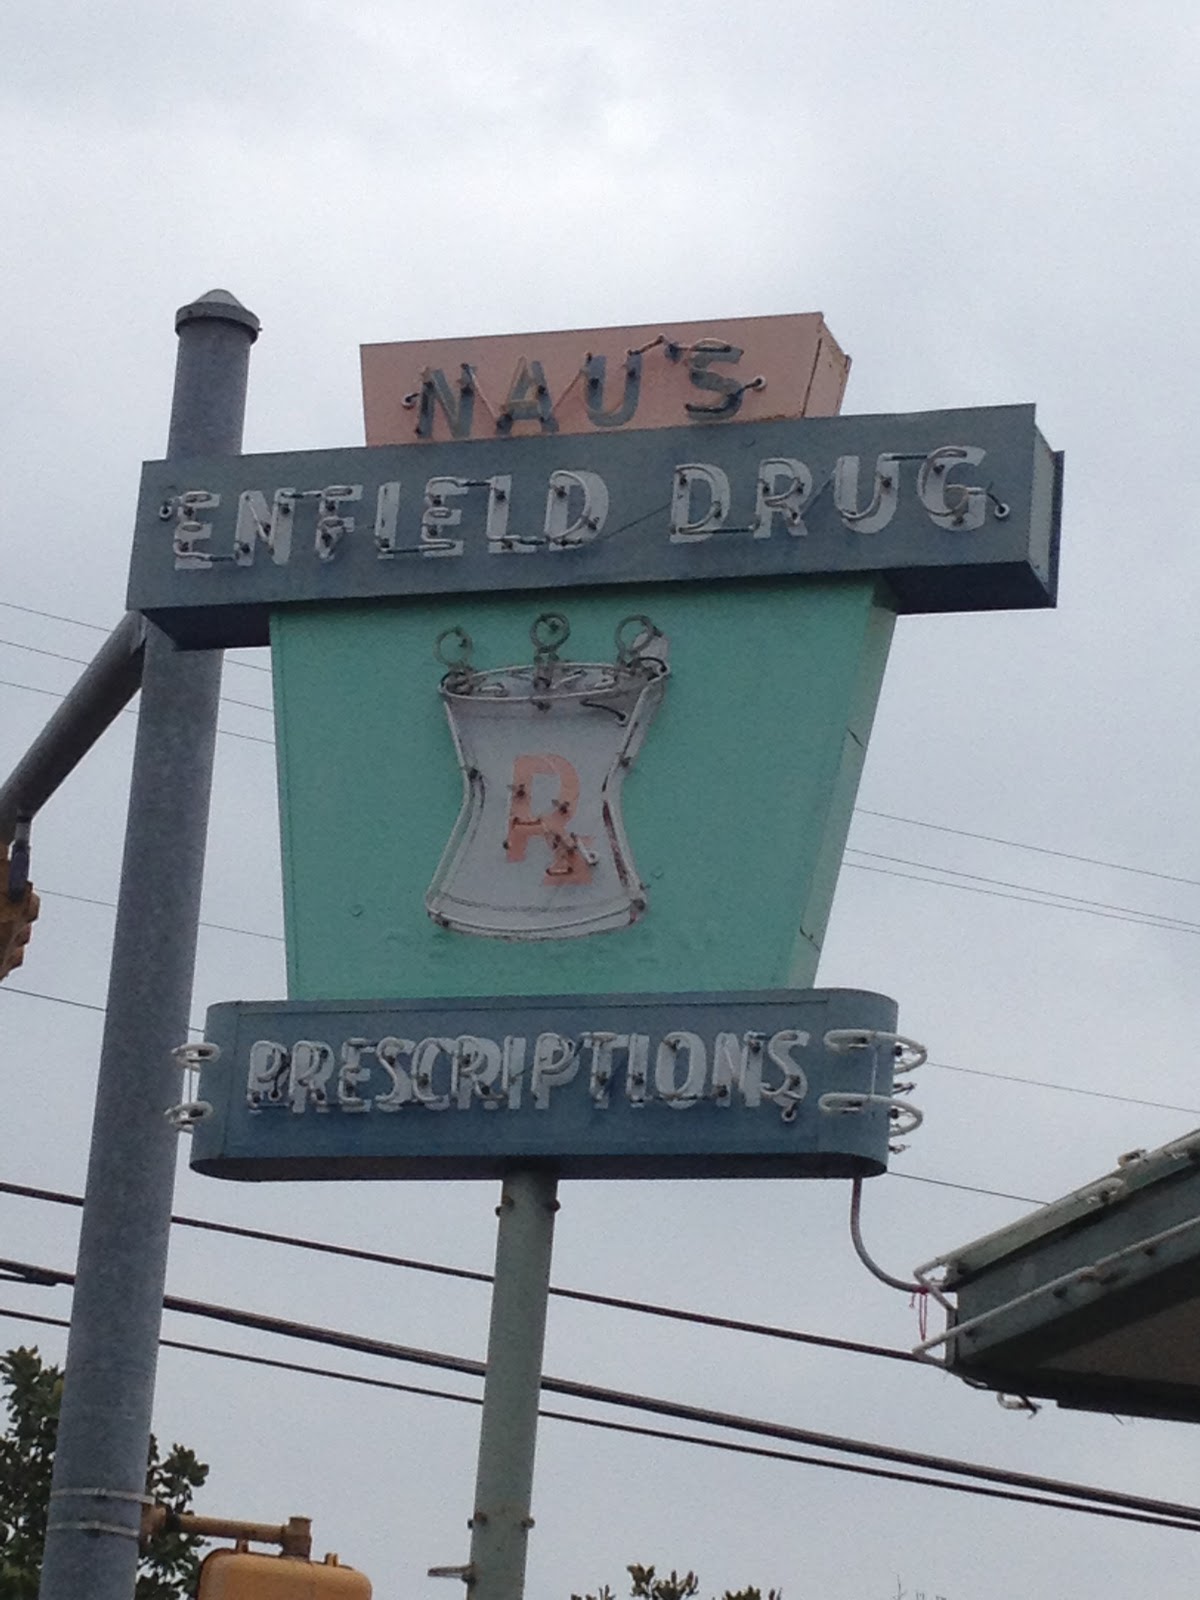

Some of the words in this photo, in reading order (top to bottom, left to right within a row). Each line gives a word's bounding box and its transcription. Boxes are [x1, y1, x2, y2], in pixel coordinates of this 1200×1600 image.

[415, 336, 744, 440] NAU'S
[174, 469, 609, 571] ENFIELD
[669, 445, 987, 544] DRUG
[246, 1029, 810, 1114] PRESCRIPTIONS
